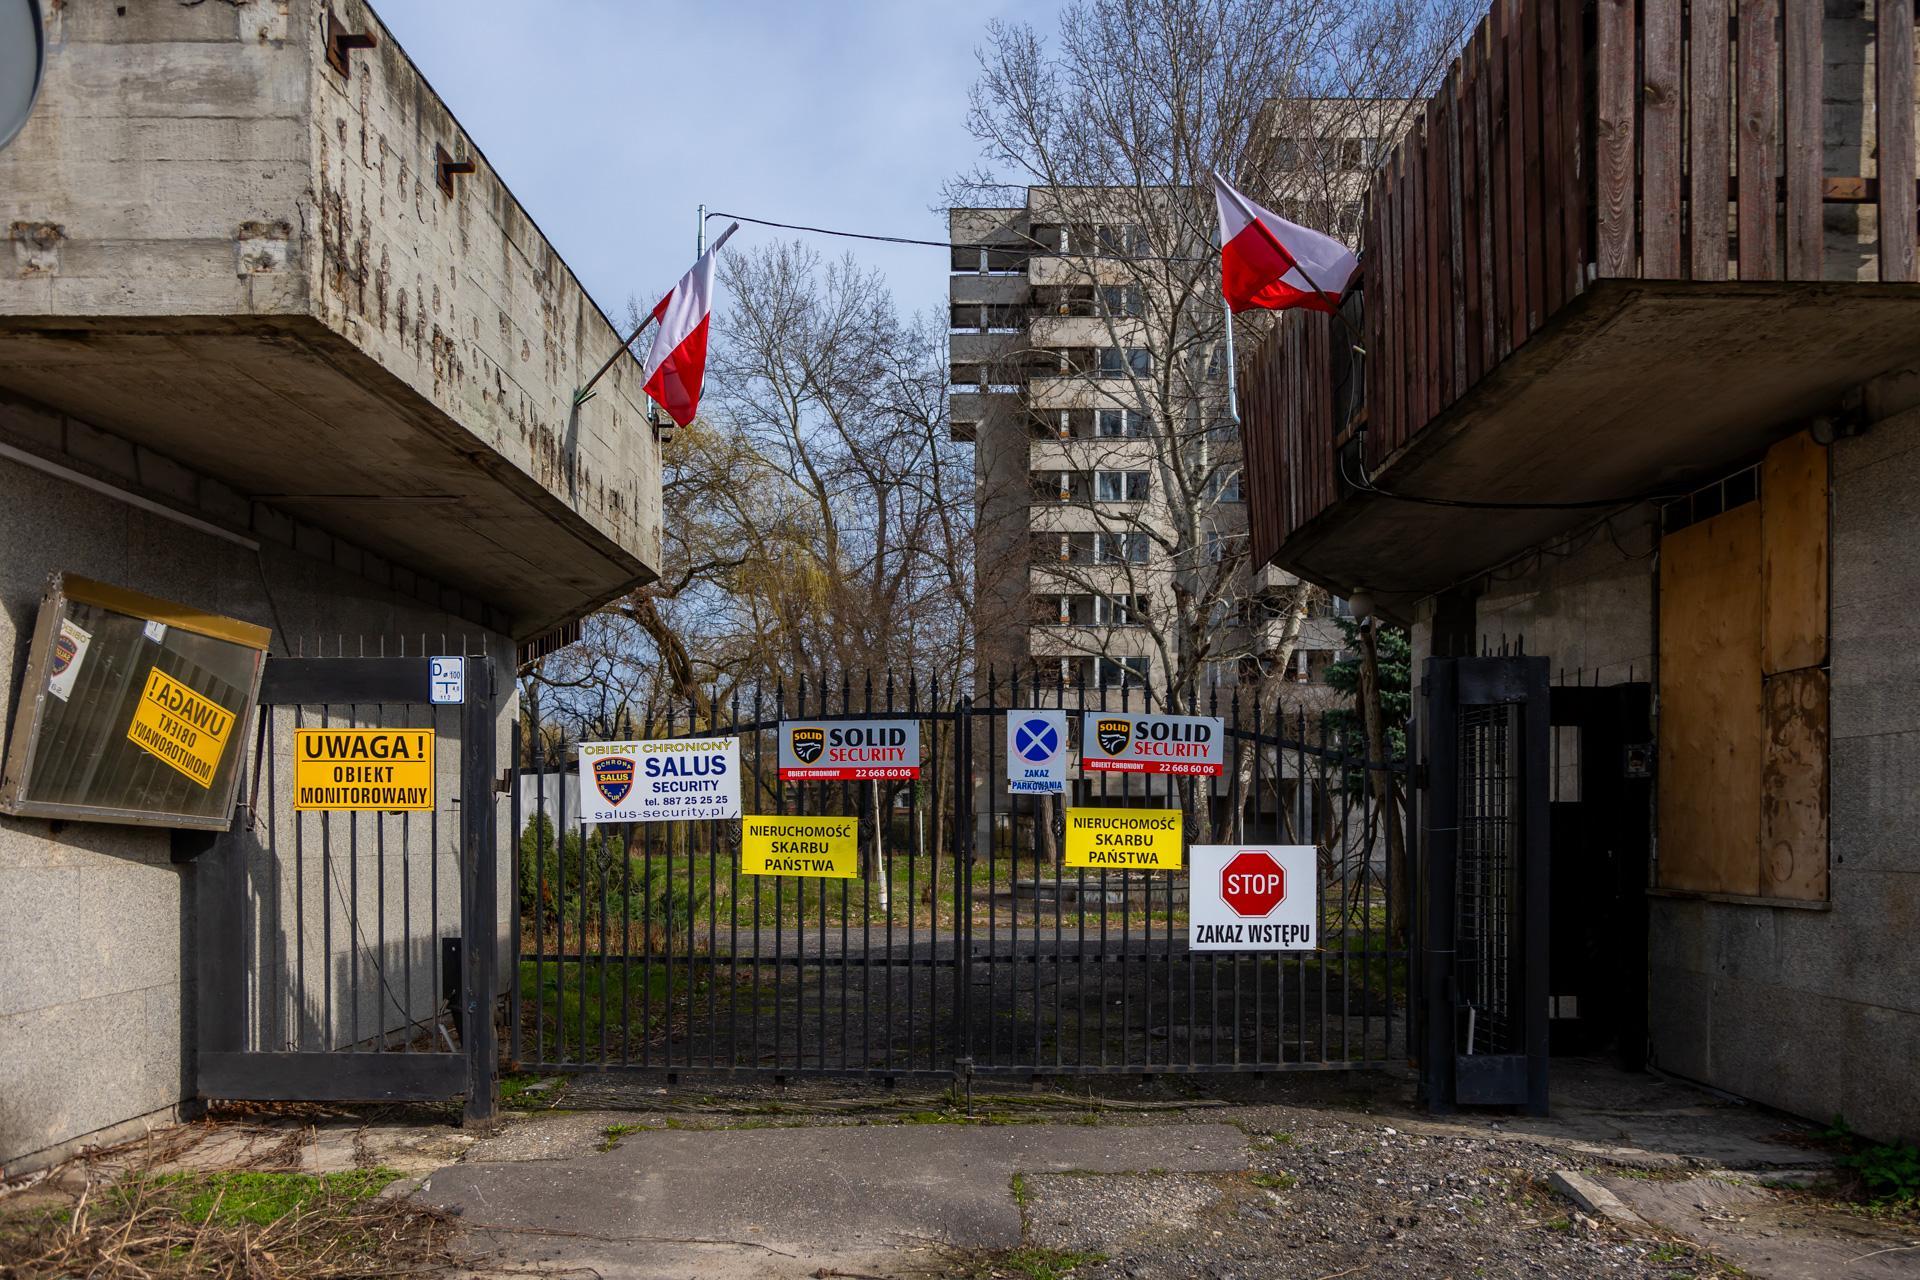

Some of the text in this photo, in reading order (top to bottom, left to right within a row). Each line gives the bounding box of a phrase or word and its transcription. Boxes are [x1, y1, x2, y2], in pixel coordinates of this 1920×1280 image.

[1100, 723, 1128, 732] SOLID
[1135, 721, 1211, 742] SOLID
[794, 732, 822, 740] SOLID
[830, 728, 906, 747] SOLID
[306, 736, 410, 758] UWAGA
[584, 741, 733, 755] OBIEKT CHRONIONY
[1134, 742, 1210, 757] SECURITY
[830, 748, 906, 761] SECURITY
[596, 759, 632, 770] OCHRONA
[645, 755, 727, 777] SALUS
[1160, 764, 1214, 773] 22 668 60 06
[334, 766, 394, 782] OBIEKT
[868, 769, 885, 777] 668
[887, 769, 898, 777] 60
[899, 769, 911, 777] 06
[1024, 769, 1049, 778] ZAKAZ
[601, 784, 628, 800] SECURITY
[652, 780, 719, 793] SECURITY
[1012, 781, 1062, 790] PARKOWANIA
[301, 788, 428, 804] MONITOROWANY
[644, 796, 728, 806] tel. 887 25 25 25
[594, 806, 724, 819] salus-security.pl
[1074, 816, 1176, 830] NIERUCHOMOŚĆ
[750, 824, 851, 837] NIERUCHOMOŚĆ
[1096, 834, 1153, 846] SKARBU
[771, 841, 829, 854] SKARBU
[1088, 848, 1159, 864] PAŃSTWA
[765, 856, 834, 871] PAŃSTWA
[1228, 874, 1280, 894] STOP
[1196, 924, 1310, 947] ZAKAZ WSTĘPU
